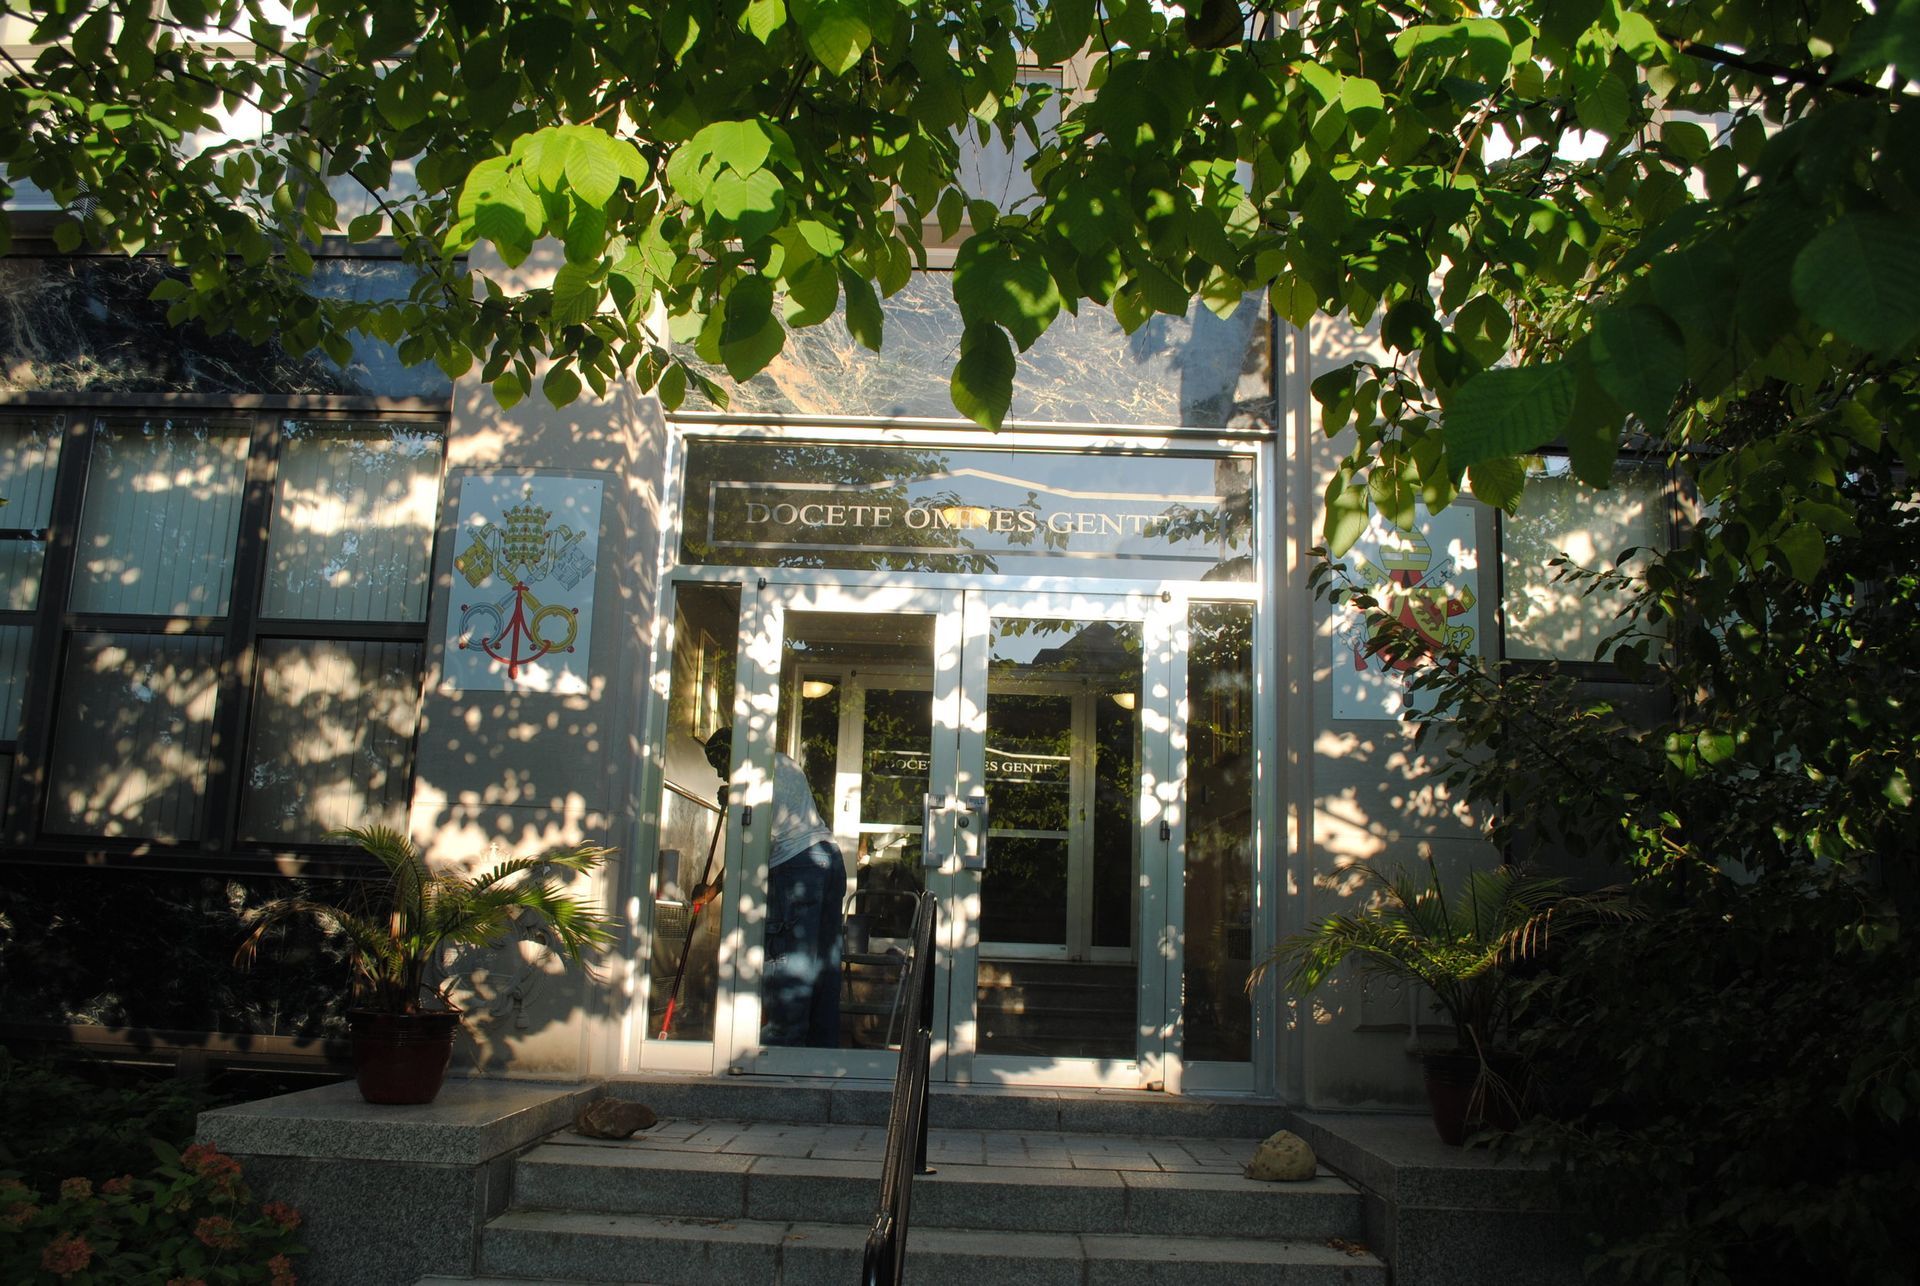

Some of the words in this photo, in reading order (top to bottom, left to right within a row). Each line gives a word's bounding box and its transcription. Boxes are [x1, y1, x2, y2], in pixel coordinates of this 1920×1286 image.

[745, 502, 893, 528] DOCETE
[904, 507, 1036, 533] OMNES
[1047, 511, 1173, 537] GENTE
